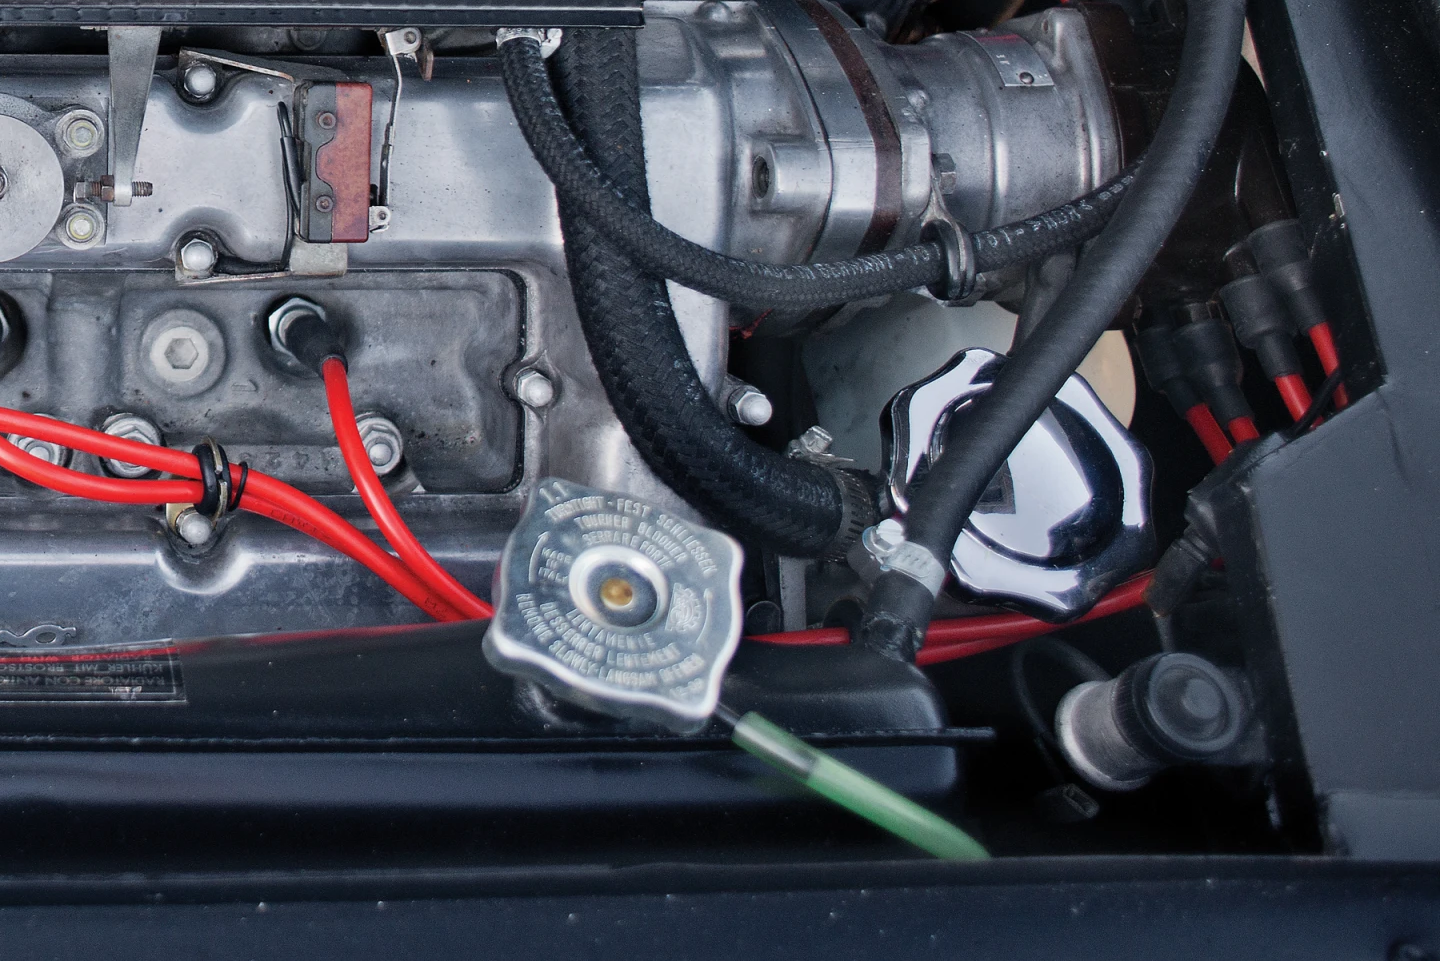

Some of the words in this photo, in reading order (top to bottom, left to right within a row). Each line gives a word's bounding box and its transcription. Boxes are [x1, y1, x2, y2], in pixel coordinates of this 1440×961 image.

[617, 498, 652, 518] FEST
[656, 514, 718, 579] SCHLIESSEN
[515, 593, 554, 644] REMOVE
[74, 664, 99, 672] MIT
[45, 676, 81, 686] CON
[85, 676, 165, 686] RADIATORE
